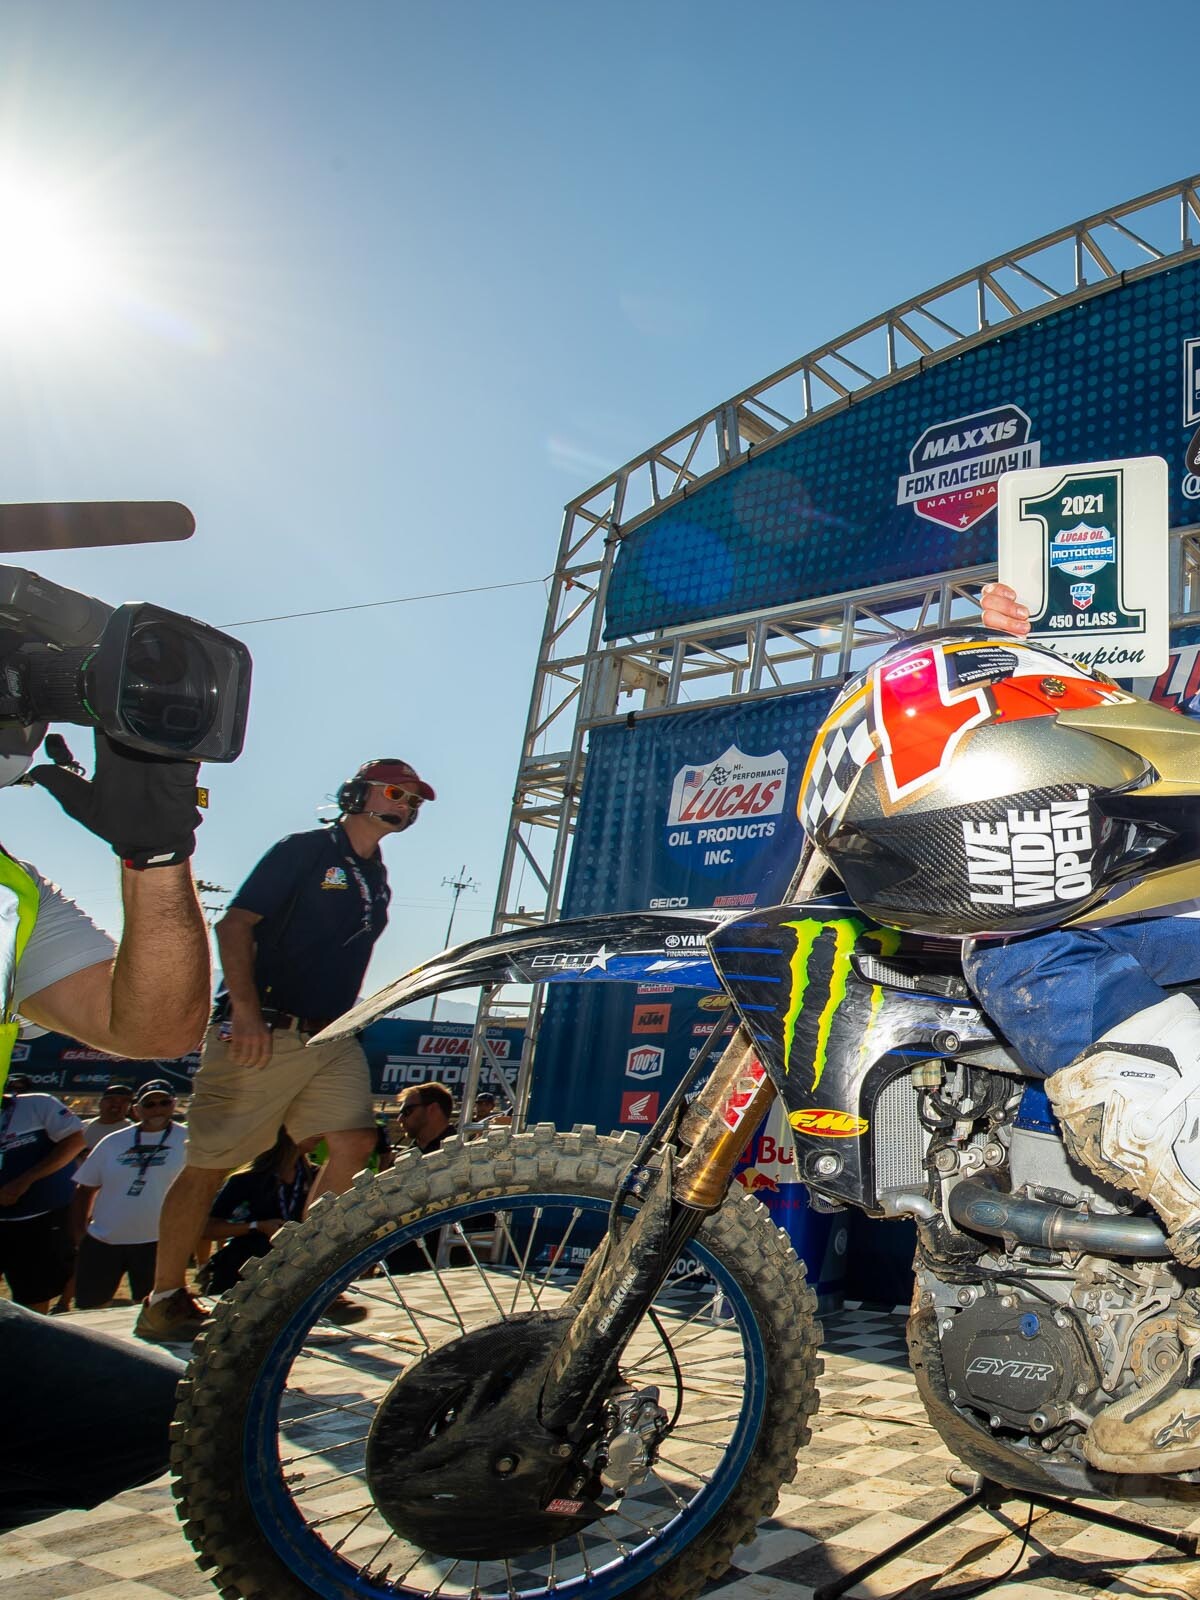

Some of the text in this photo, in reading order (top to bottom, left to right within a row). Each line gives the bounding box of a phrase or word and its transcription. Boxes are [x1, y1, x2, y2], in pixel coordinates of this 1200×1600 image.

[922, 419, 1018, 461] MAXXIS
[905, 474, 935, 497] FOX
[938, 453, 1018, 489] RACEWAY
[927, 486, 998, 508] NATIONA
[1061, 493, 1104, 516] 2021
[1060, 530, 1104, 543] LUCAS OIL
[1019, 469, 1146, 639] 1
[1052, 546, 1113, 559] MOTOCROSS
[1049, 612, 1117, 628] 450 CLASS
[732, 768, 785, 780] PERFORMANCE
[678, 779, 782, 822] LUCAS
[668, 822, 776, 847] OIL PRODUCTS
[1051, 789, 1092, 900] OPEN.
[704, 850, 734, 866] INC.
[962, 821, 1013, 905] LIVE
[1007, 809, 1055, 908] WIDE
[649, 897, 689, 909] GEICO
[681, 935, 707, 947] YAM
[638, 1011, 665, 1026] KTM
[693, 1025, 734, 1034] GASS
[631, 1053, 659, 1071] 100%
[790, 1111, 868, 1132] FMF
[572, 1247, 591, 1259] PRO
[966, 1356, 1054, 1382] GYTR
